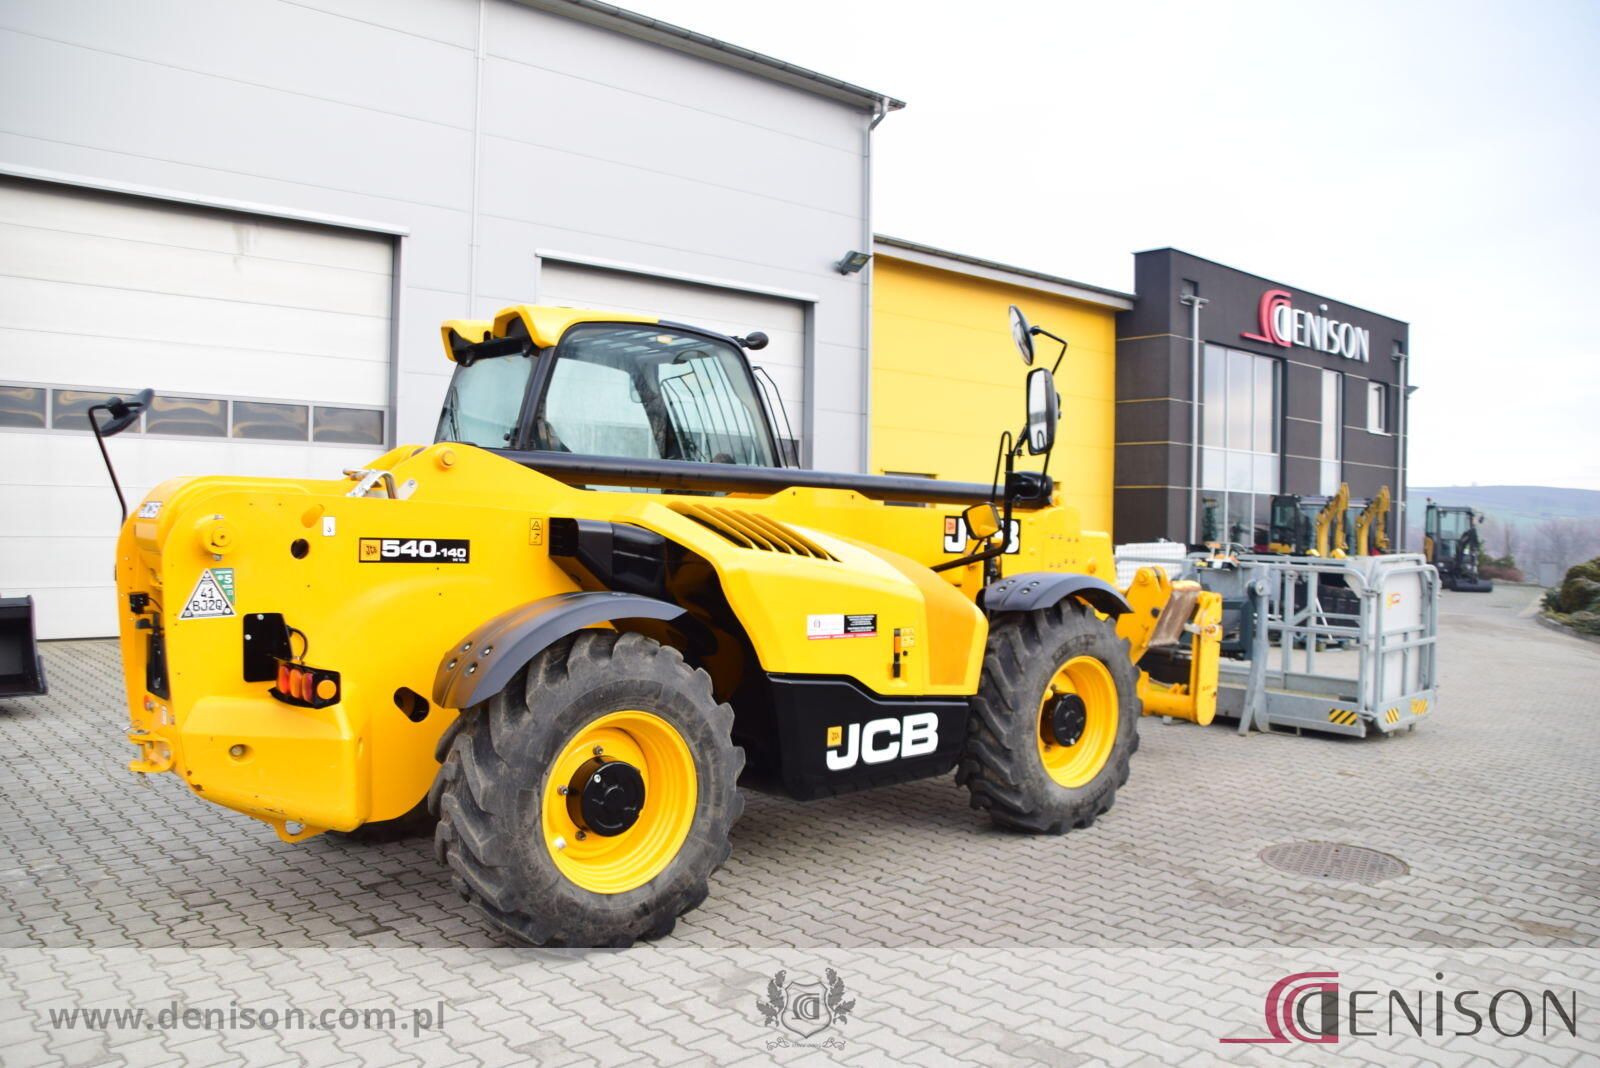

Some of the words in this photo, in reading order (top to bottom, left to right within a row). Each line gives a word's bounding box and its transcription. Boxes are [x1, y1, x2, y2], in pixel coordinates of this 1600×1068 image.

[381, 539, 467, 558] 540-140
[201, 587, 214, 599] 41
[826, 711, 939, 772] JCB
